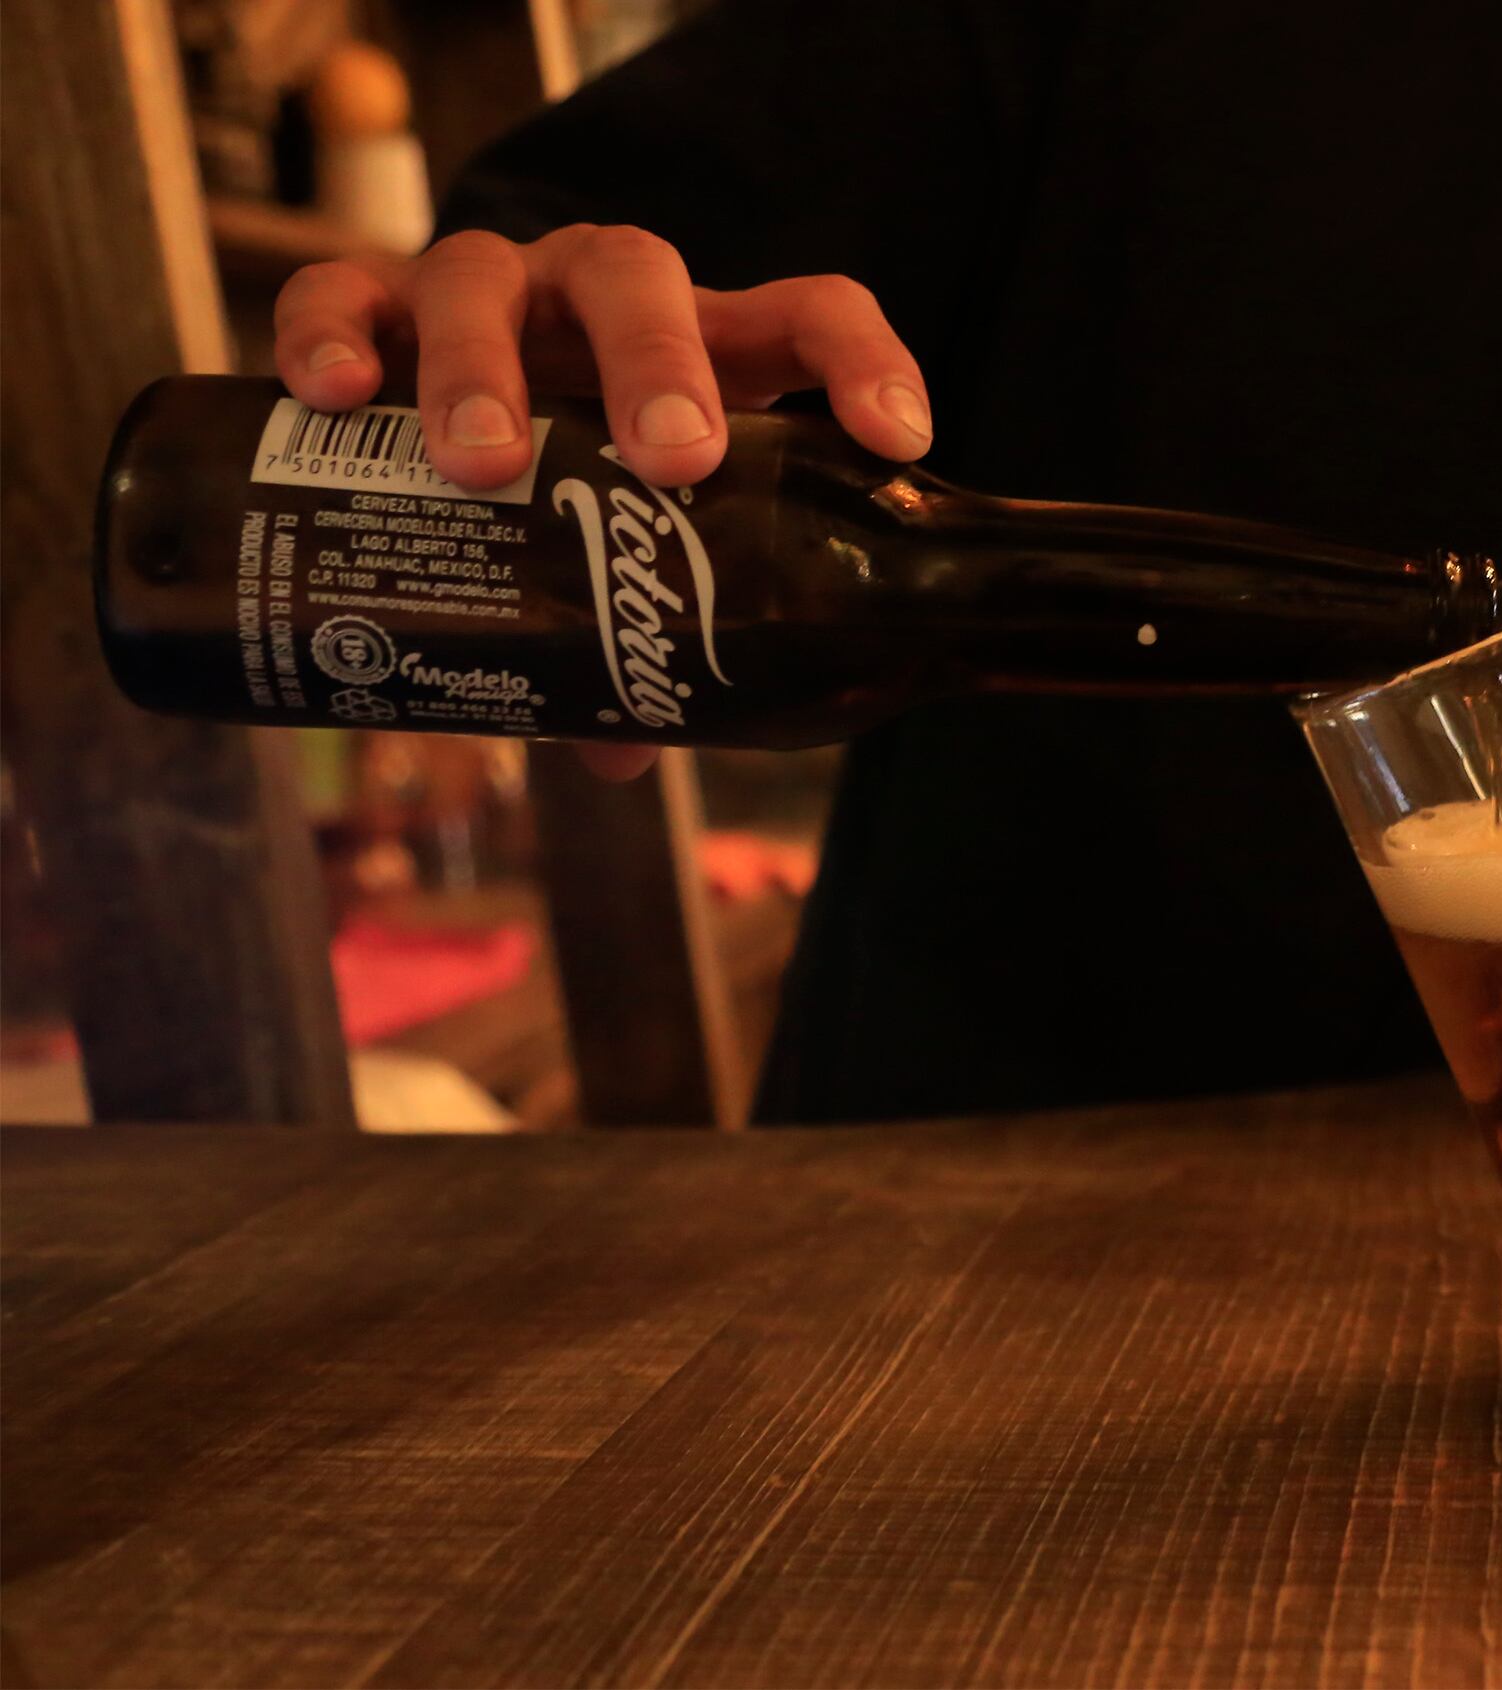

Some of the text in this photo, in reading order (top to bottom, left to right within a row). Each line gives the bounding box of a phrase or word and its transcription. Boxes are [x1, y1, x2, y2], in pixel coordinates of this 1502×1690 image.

[266, 455, 449, 485] 7 501064 11
[352, 495, 494, 520] CERVEZA TIPO VIENA
[275, 513, 299, 530] EL
[314, 511, 384, 531] CERVECERIA
[238, 511, 267, 577] PRODUCTO
[270, 532, 296, 576] ABUSO
[350, 534, 391, 551] LAGO
[394, 538, 458, 557] ALBERTO
[318, 550, 514, 581] COL. ANAHUAC, MEXICO, D.F.
[237, 578, 260, 595] ES
[269, 580, 292, 598] EN
[308, 569, 521, 600] C.P. 11320 www.gmodelo.com
[237, 598, 261, 641] NOCIVO
[269, 602, 291, 616] EL
[412, 666, 530, 692] Modelo
